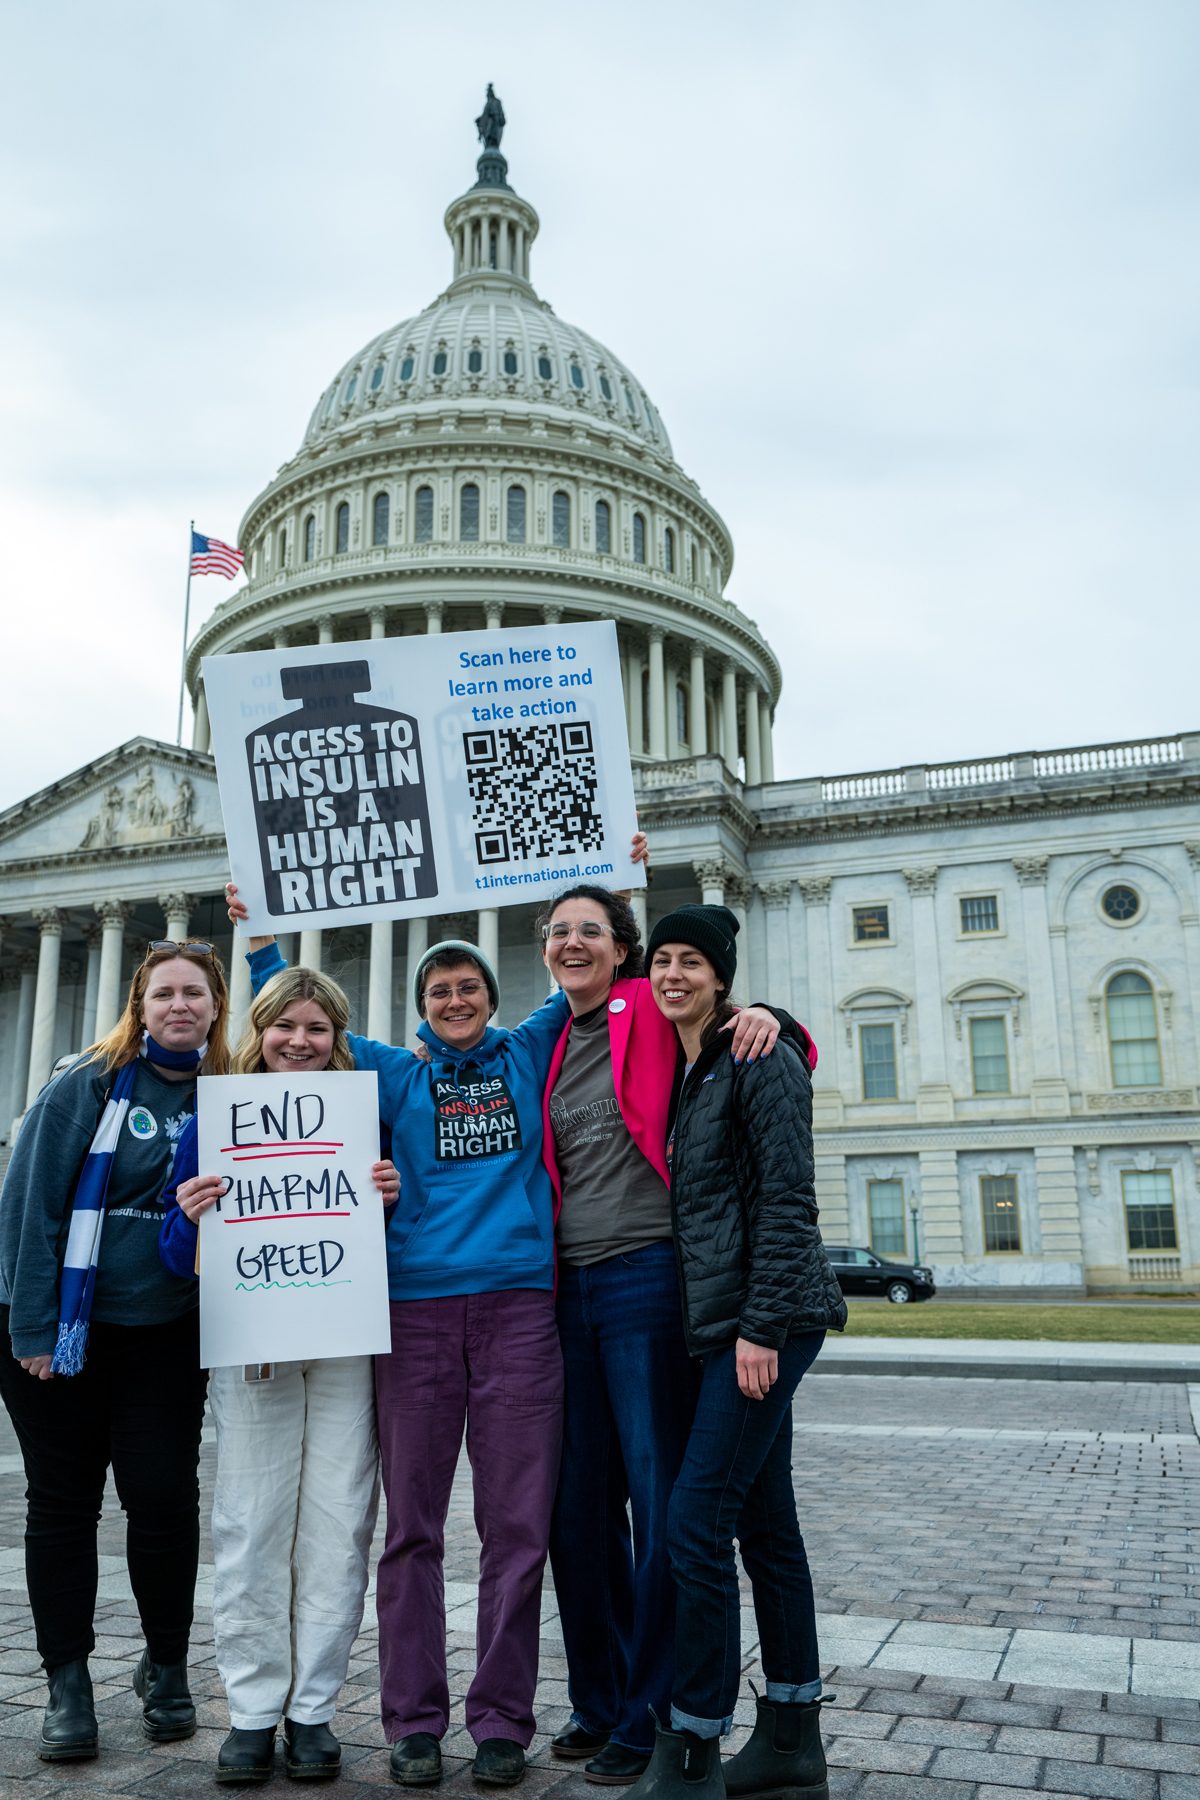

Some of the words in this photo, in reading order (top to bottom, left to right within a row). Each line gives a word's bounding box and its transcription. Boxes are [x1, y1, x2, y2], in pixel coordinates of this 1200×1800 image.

[459, 650, 504, 668] Scan
[509, 647, 552, 665] here
[557, 644, 577, 661] to
[448, 679, 498, 697] learn
[503, 673, 553, 692] more
[559, 668, 593, 687] and
[472, 702, 514, 722] take
[520, 698, 577, 718] action
[253, 724, 364, 764] ACCESS
[371, 719, 413, 750] TO
[254, 748, 420, 802] INSULIN
[303, 796, 337, 829] IS
[357, 792, 381, 823] A
[267, 818, 424, 871] HUMAN
[279, 857, 421, 913] RIGHT
[475, 861, 614, 889] t1international.com
[436, 1078, 503, 1098] ACCESS
[463, 1095, 478, 1106] O
[229, 1090, 326, 1147] END
[440, 1097, 508, 1116] INSULIN
[464, 1114, 475, 1123] IS
[478, 1114, 488, 1122] A
[439, 1113, 516, 1137] HUMAN
[440, 1129, 517, 1158] RIGHT
[215, 1168, 359, 1217] PHARMA
[236, 1240, 345, 1283] GREED
